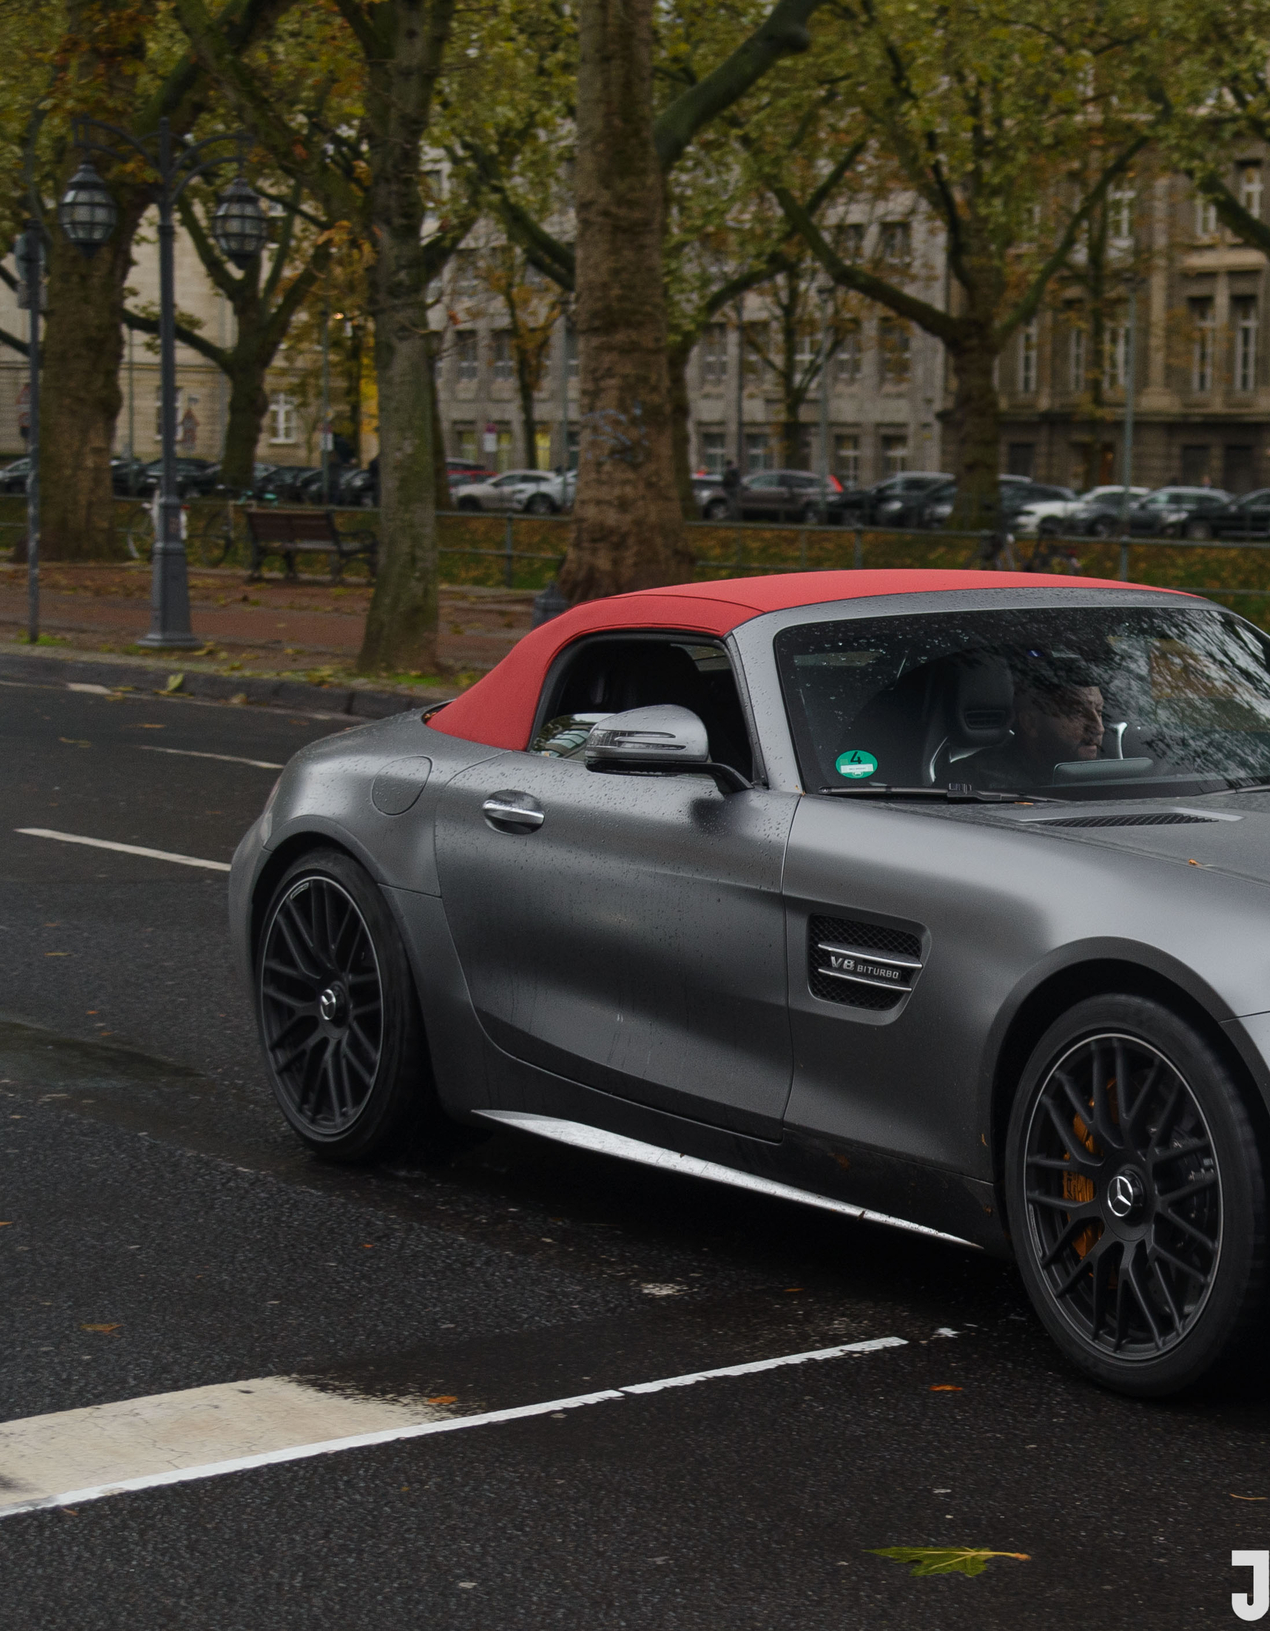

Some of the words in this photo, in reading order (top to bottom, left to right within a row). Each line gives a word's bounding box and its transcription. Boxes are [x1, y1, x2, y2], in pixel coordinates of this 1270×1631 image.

[850, 751, 863, 764] 4
[830, 956, 855, 971] V8
[857, 964, 899, 979] BITURBO
